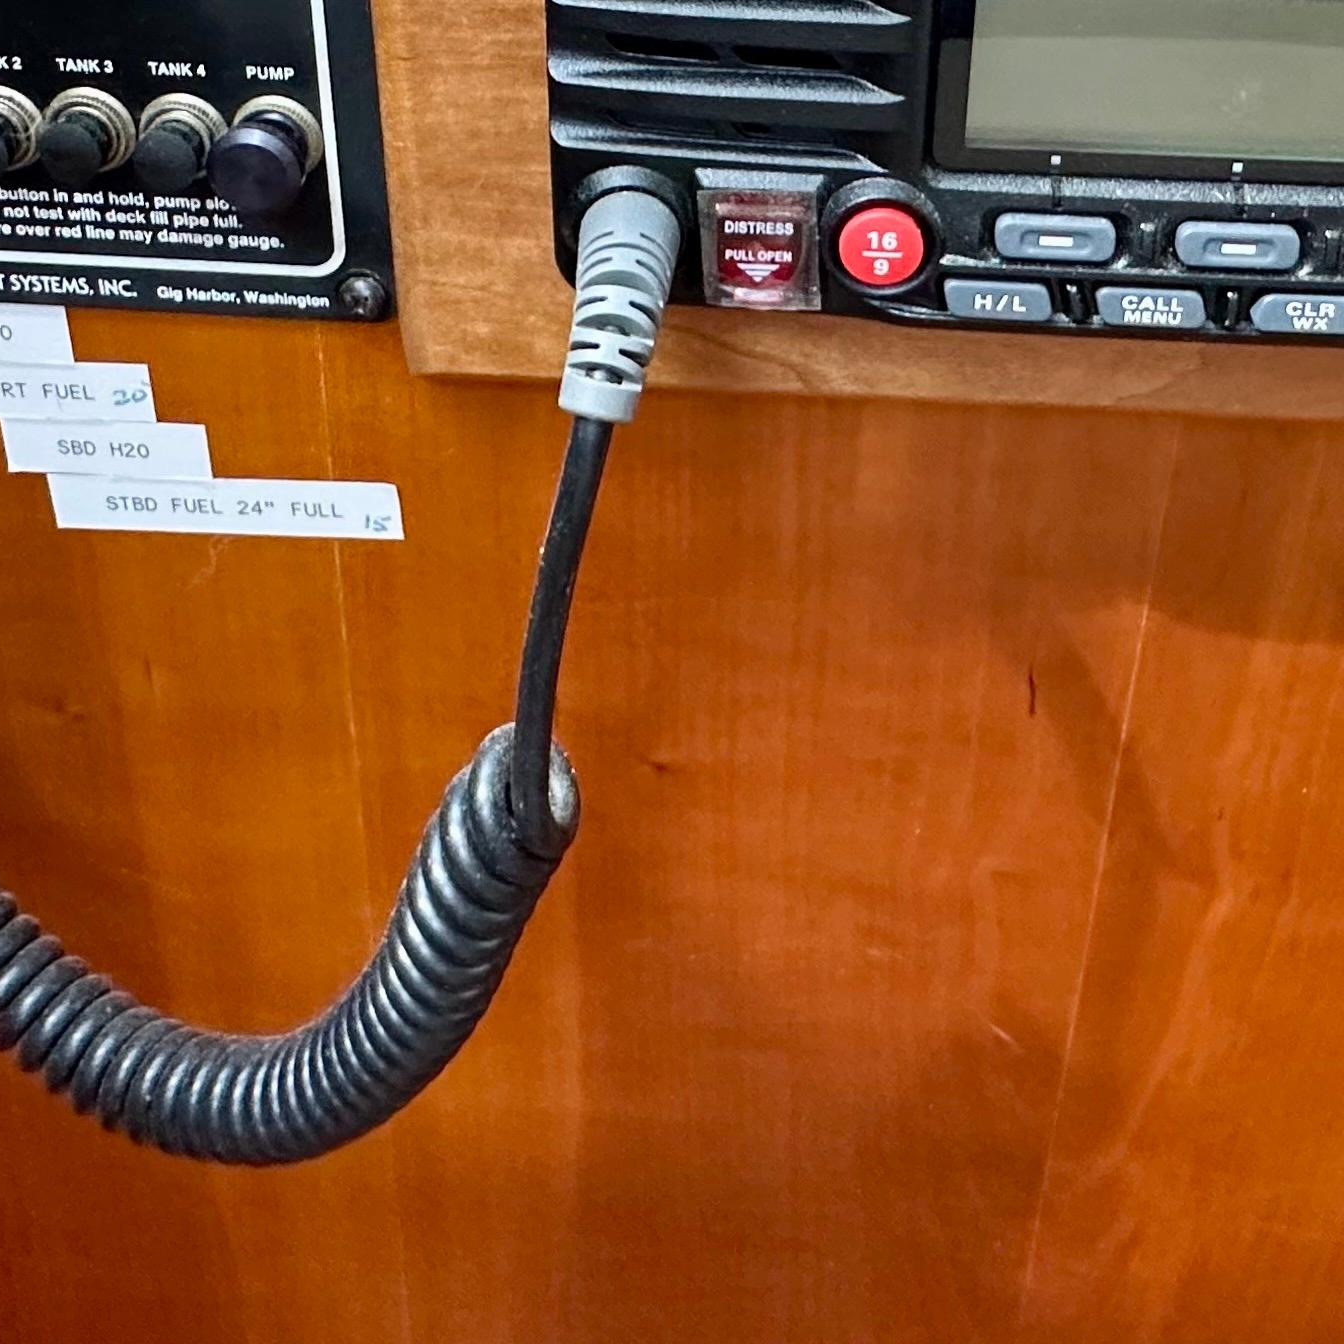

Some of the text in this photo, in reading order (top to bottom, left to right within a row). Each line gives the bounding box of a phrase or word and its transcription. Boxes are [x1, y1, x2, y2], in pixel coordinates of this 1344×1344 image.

[12, 56, 22, 70] 2
[56, 58, 113, 74] TANK 3
[148, 61, 206, 77] TANK 4
[246, 66, 294, 80] PUMP
[53, 188, 68, 202] in
[73, 191, 104, 204] and
[108, 192, 149, 208] hold,
[154, 197, 201, 211] pump
[3, 206, 30, 218] not
[33, 206, 64, 220] test
[68, 207, 101, 221] with
[105, 209, 146, 224] deck
[150, 211, 169, 225] fill
[173, 212, 209, 228] pipe
[213, 214, 242, 228] full.
[724, 217, 793, 236] DISTRESS
[16, 225, 50, 236] over
[55, 225, 82, 238] red
[85, 225, 115, 240] line
[119, 230, 152, 244] may
[157, 229, 223, 248] damage
[228, 235, 284, 251] gauge.
[867, 232, 897, 250] 16
[723, 248, 794, 264] PULL OPEN
[874, 259, 888, 275] 9
[10, 274, 94, 295] SYSTEMS,
[98, 279, 137, 297] INC.
[157, 286, 329, 309] Gig Harbor, Washington
[973, 292, 1027, 312] H/L
[1122, 294, 1185, 313] CALL
[1123, 308, 1181, 325] MENU
[1284, 300, 1335, 317] CLR
[1291, 316, 1327, 330] WX
[42, 383, 95, 400] FUEL
[57, 440, 96, 456] SBD
[106, 496, 157, 512] STBD
[171, 498, 222, 514] FUEL
[291, 502, 343, 518] FULL
